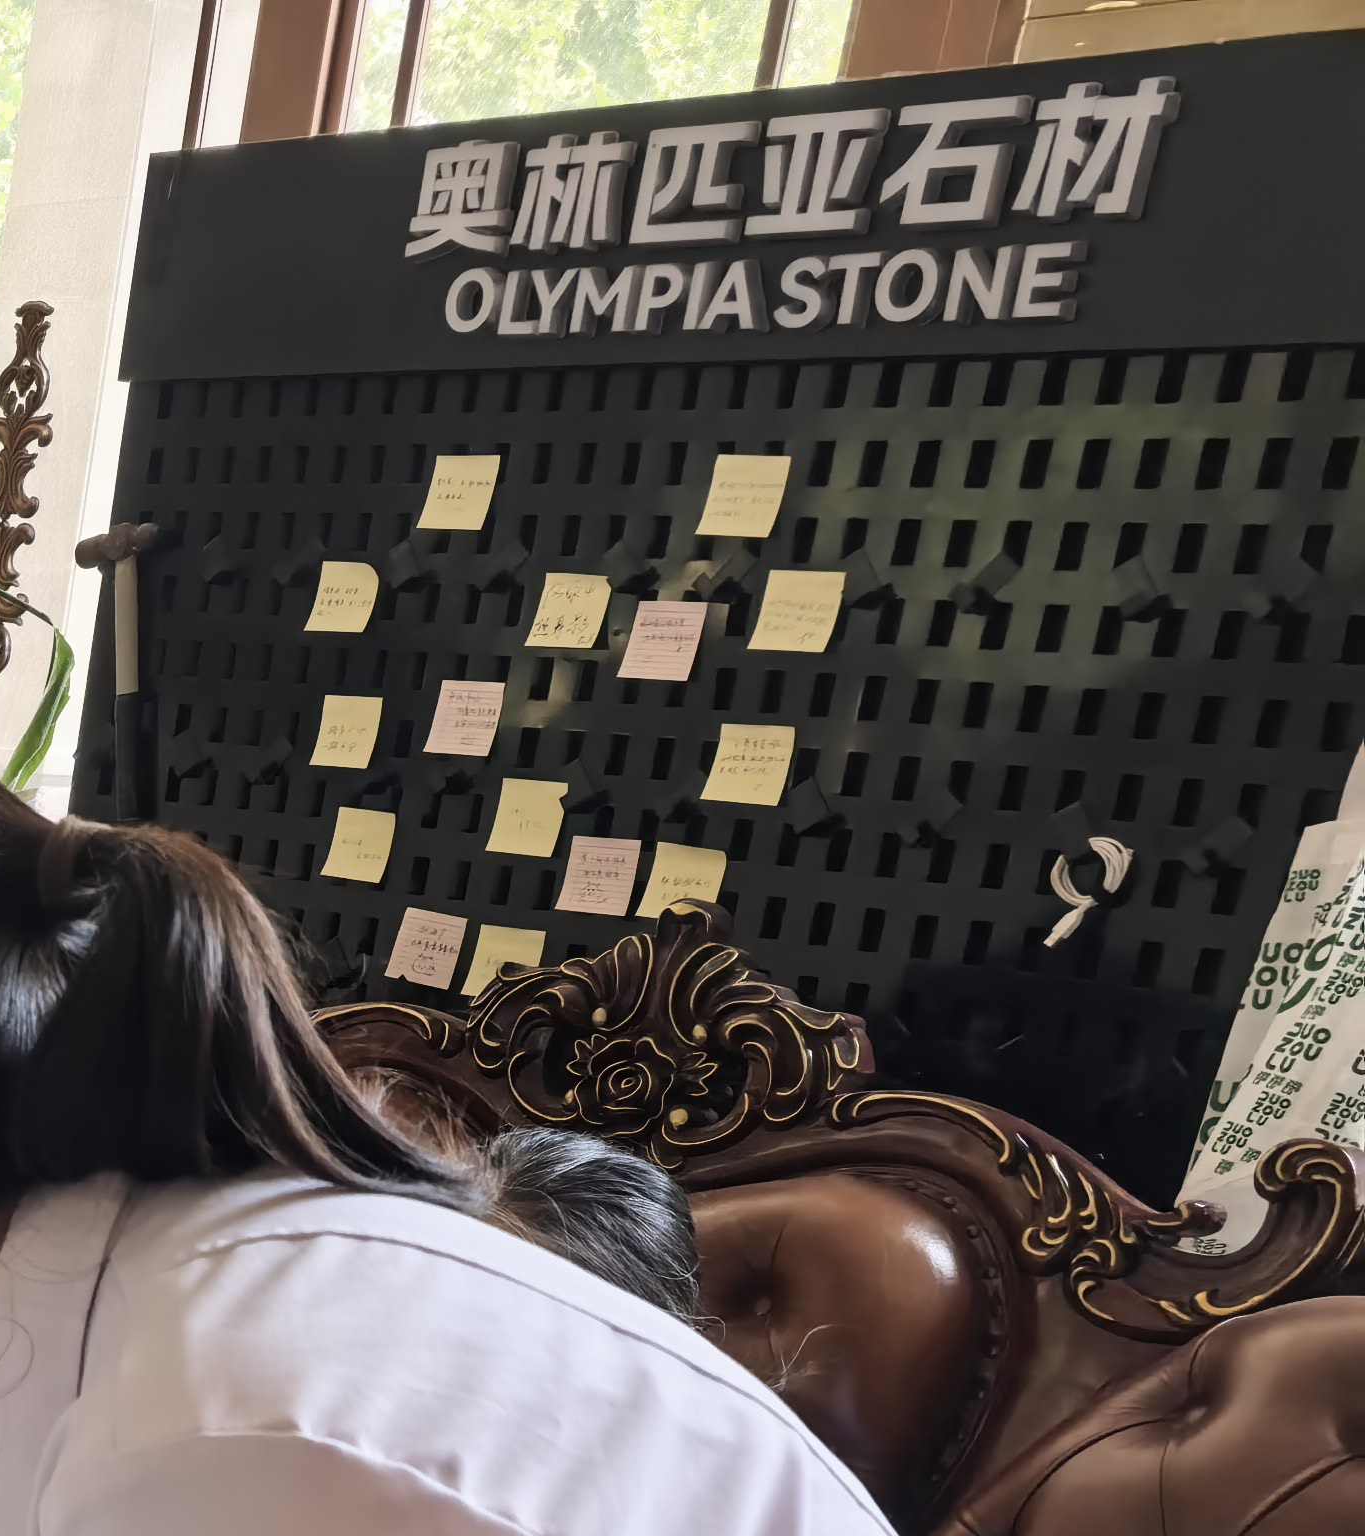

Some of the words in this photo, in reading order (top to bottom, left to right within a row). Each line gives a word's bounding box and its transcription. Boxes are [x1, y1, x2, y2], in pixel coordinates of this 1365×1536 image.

[405, 77, 1180, 262] 奥林匹亚石材
[446, 257, 770, 336] OLYMPIA
[773, 241, 1087, 327] STONE
[1286, 880, 1319, 891] ZOU
[1284, 892, 1306, 903] LU
[1324, 981, 1360, 998] ZOU
[1274, 1037, 1323, 1061] ZOU
[1265, 1053, 1296, 1073] LU
[1246, 1112, 1269, 1126] LU
[1252, 1102, 1286, 1119] ZOU
[1326, 1104, 1362, 1122] ZOU
[1321, 1114, 1346, 1129] LU
[1217, 1131, 1248, 1148] ZOU
[1211, 1142, 1232, 1155] LU
